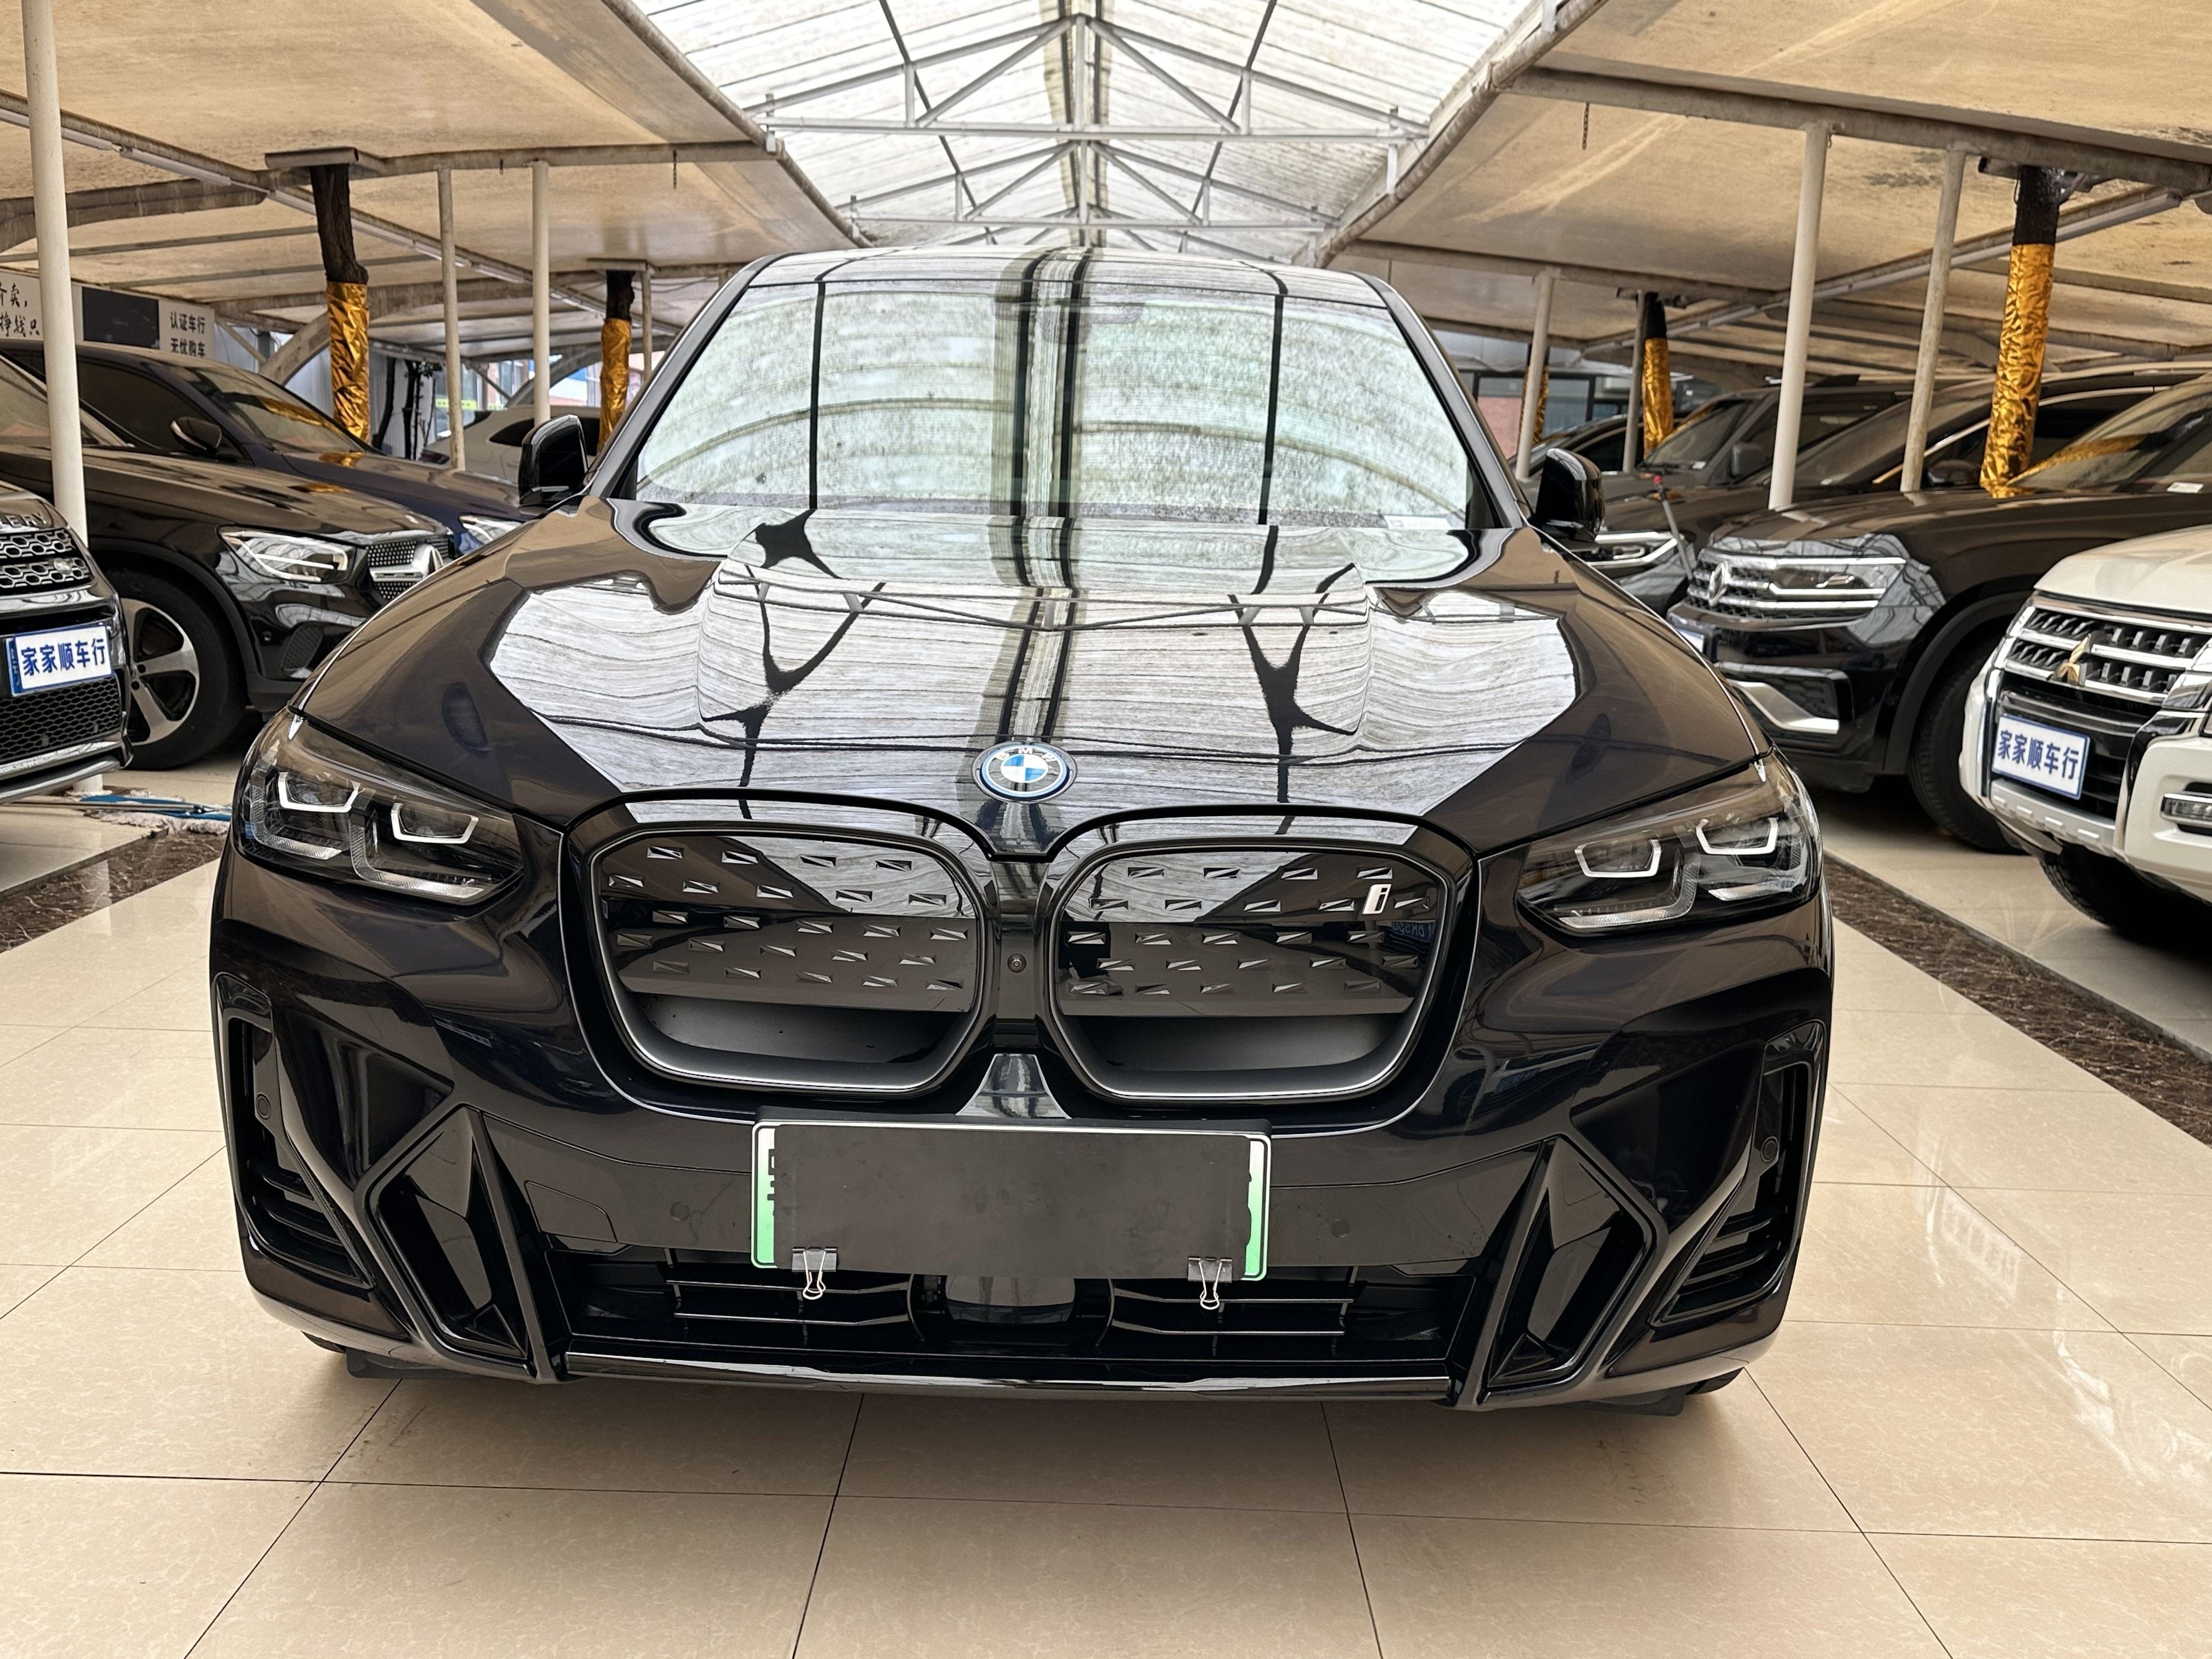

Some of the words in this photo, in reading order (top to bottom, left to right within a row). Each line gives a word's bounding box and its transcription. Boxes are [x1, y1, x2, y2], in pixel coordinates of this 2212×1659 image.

[170, 311, 205, 334] 认证车行
[21, 638, 105, 676] 家家顺车行
[995, 747, 1058, 763] BMW
[1997, 729, 2079, 780] 家家顺车行
